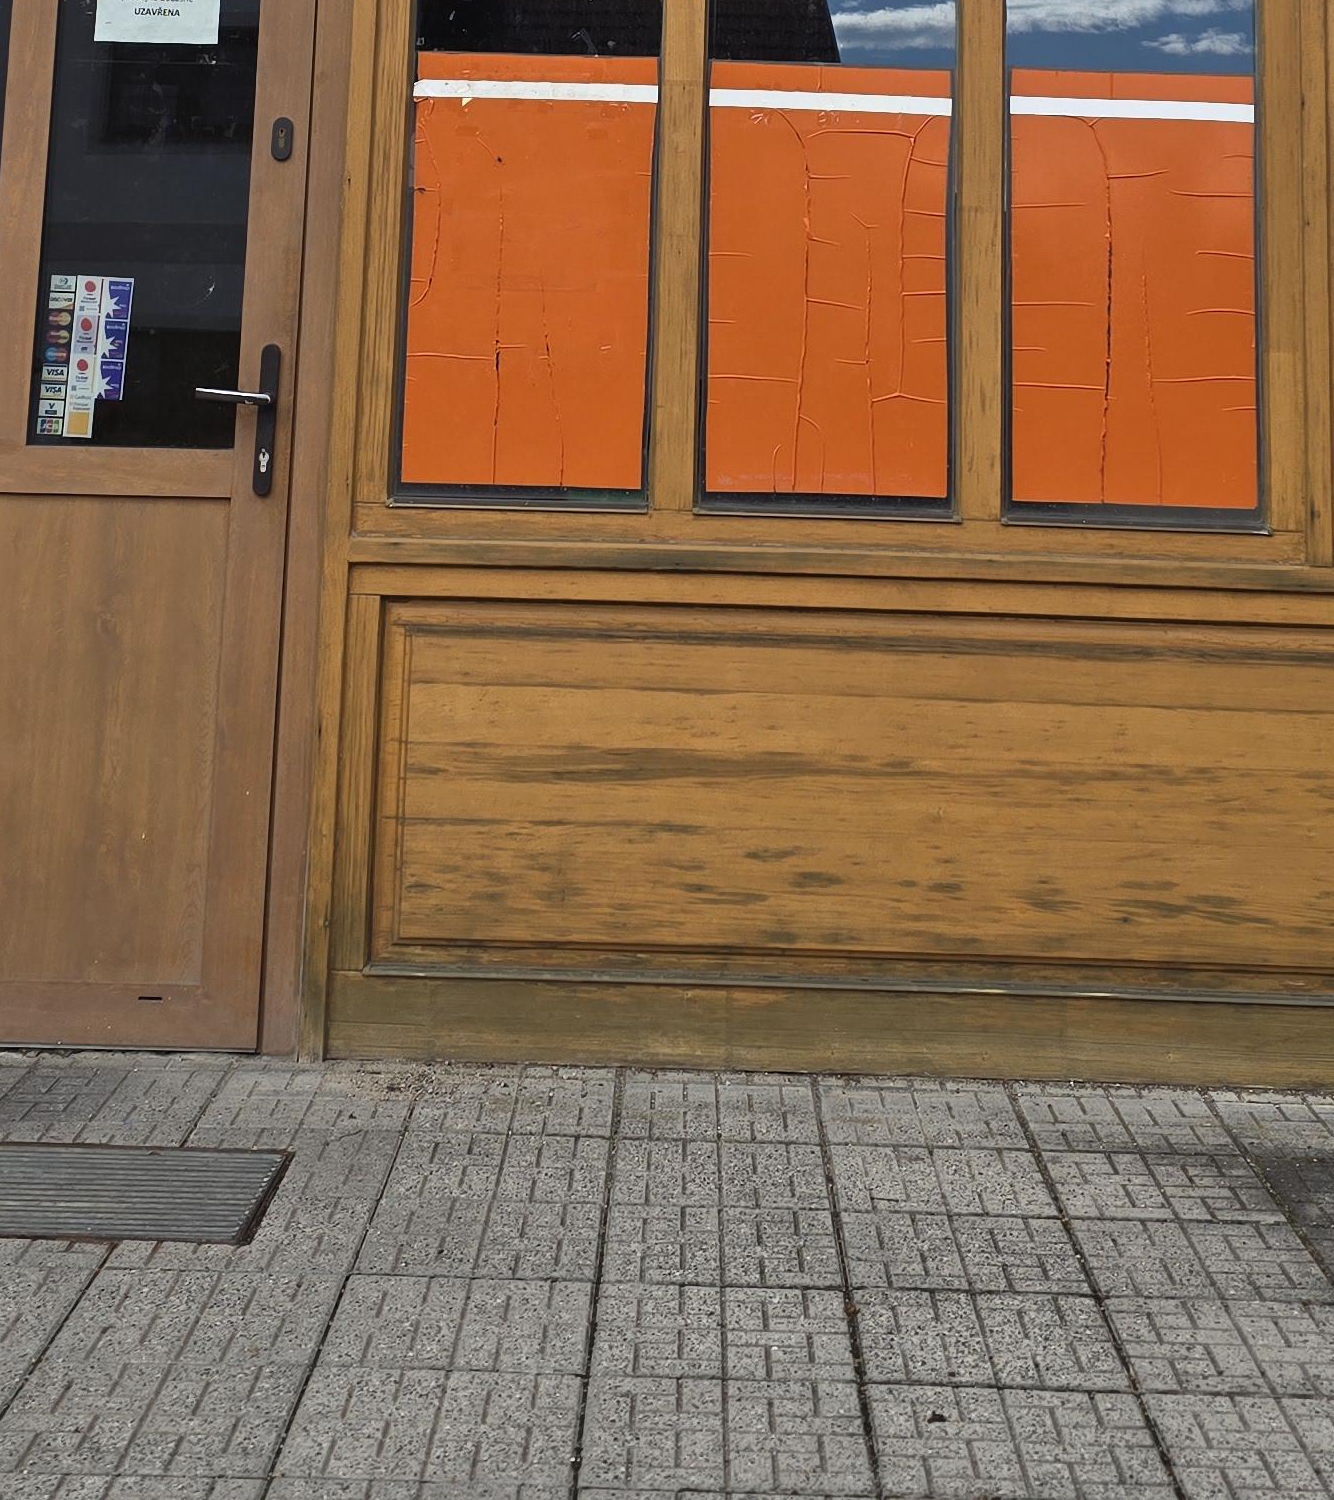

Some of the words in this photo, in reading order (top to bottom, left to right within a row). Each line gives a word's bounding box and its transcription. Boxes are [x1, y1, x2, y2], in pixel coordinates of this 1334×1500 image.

[134, 7, 181, 17] UZAVŘENA
[46, 368, 65, 376] VISA
[44, 385, 62, 393] VISA
